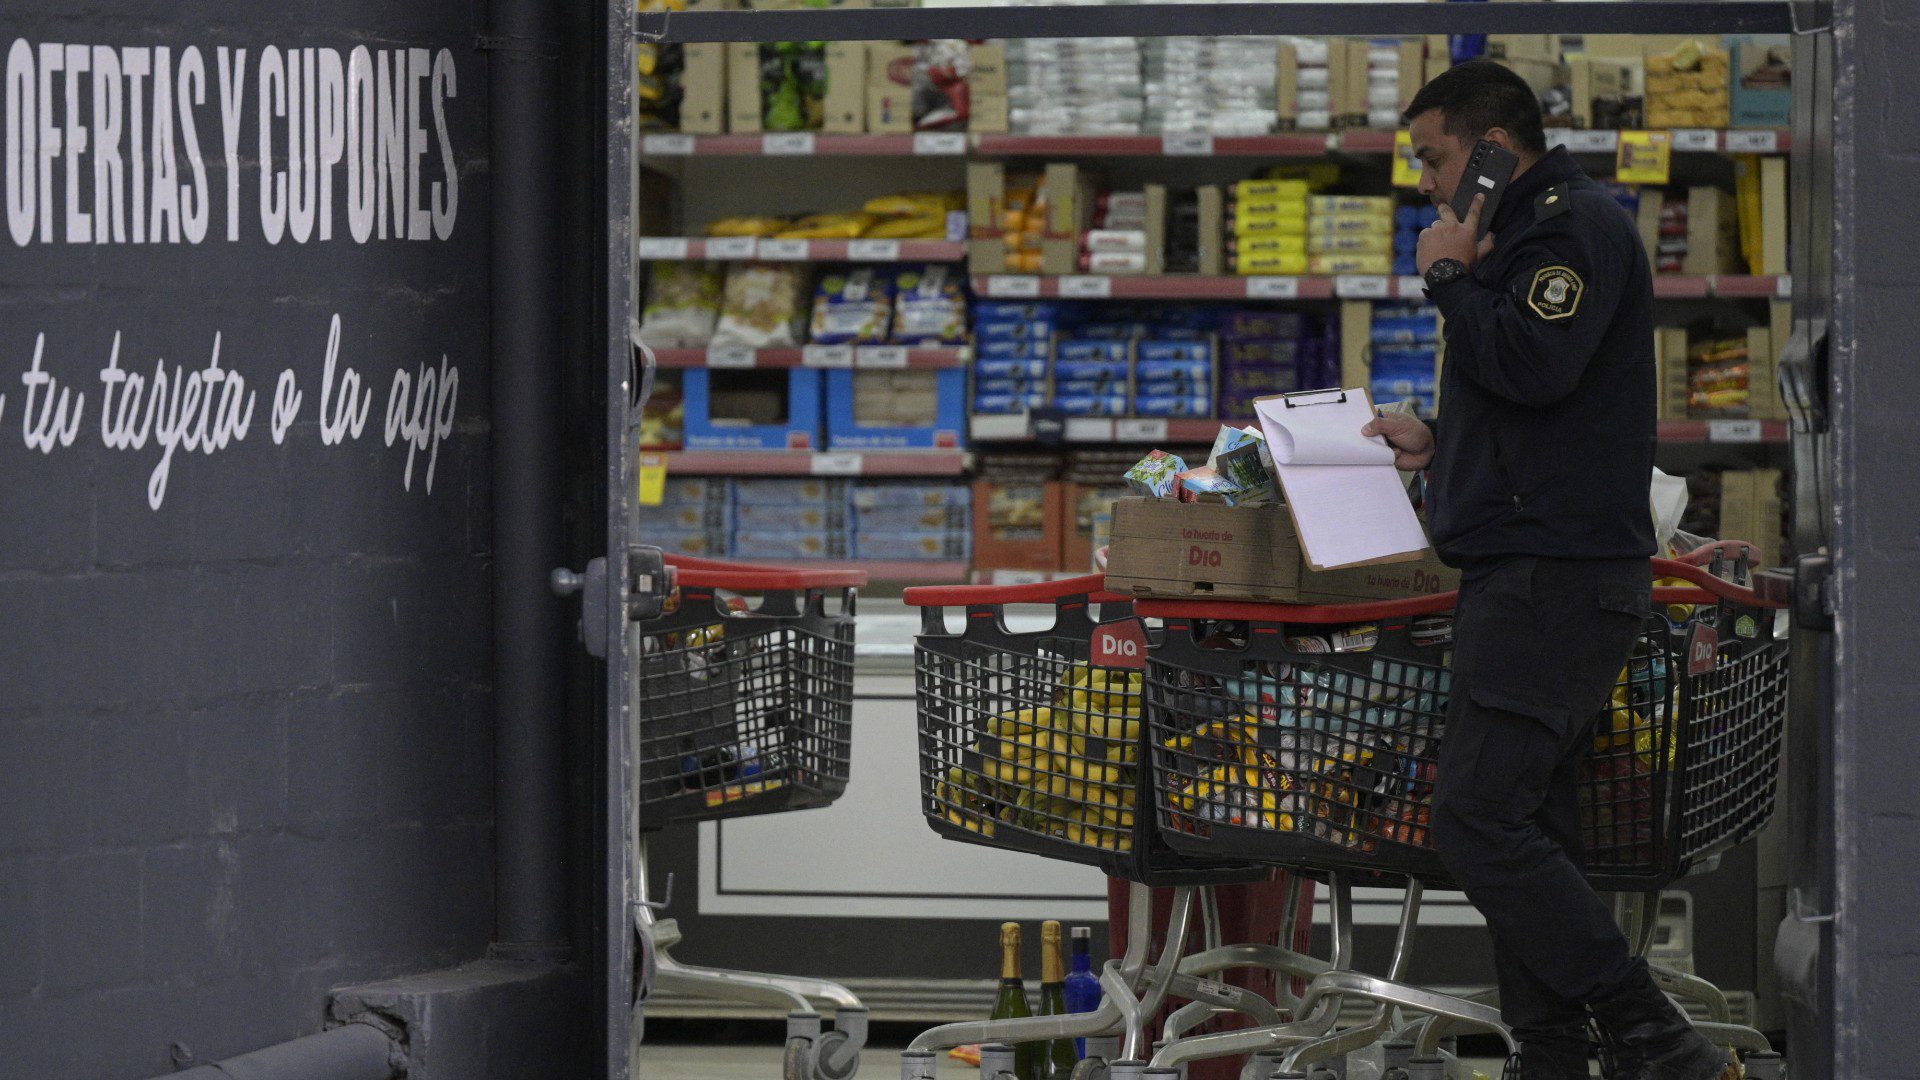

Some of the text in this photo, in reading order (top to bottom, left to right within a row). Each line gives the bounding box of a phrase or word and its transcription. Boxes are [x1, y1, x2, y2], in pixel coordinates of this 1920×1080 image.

[6, 38, 458, 247] OFERTAS Y CUPONES
[21, 313, 458, 511] tu tarjeta o la app
[1183, 528, 1233, 542] La huerta de
